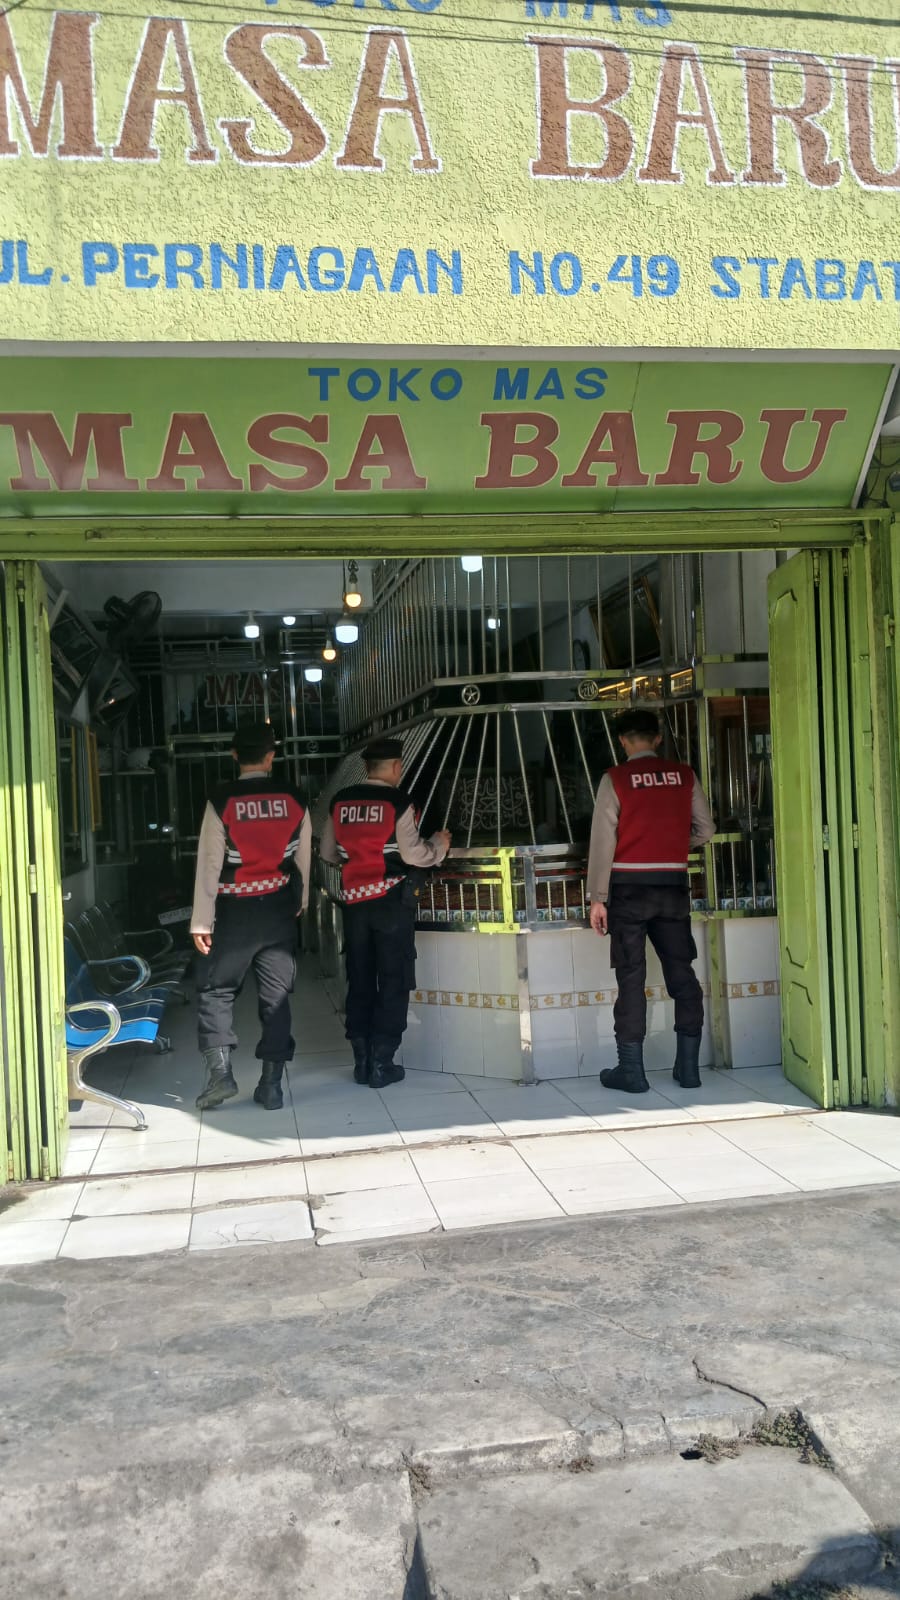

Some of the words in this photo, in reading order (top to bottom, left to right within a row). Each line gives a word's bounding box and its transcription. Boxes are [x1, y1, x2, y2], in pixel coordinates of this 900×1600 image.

[0, 8, 443, 173] MASA
[526, 35, 900, 191] BARU
[82, 241, 463, 295] PERNIAGAAN
[509, 249, 680, 297] NO.49
[710, 255, 900, 301] STABAT
[308, 367, 463, 401] TOKO
[494, 367, 607, 400] MAS
[0, 411, 428, 492] MASA
[475, 409, 847, 489] BARU
[631, 771, 682, 788] POLISI
[236, 800, 288, 820] POLISI
[340, 805, 384, 823] POLISI
